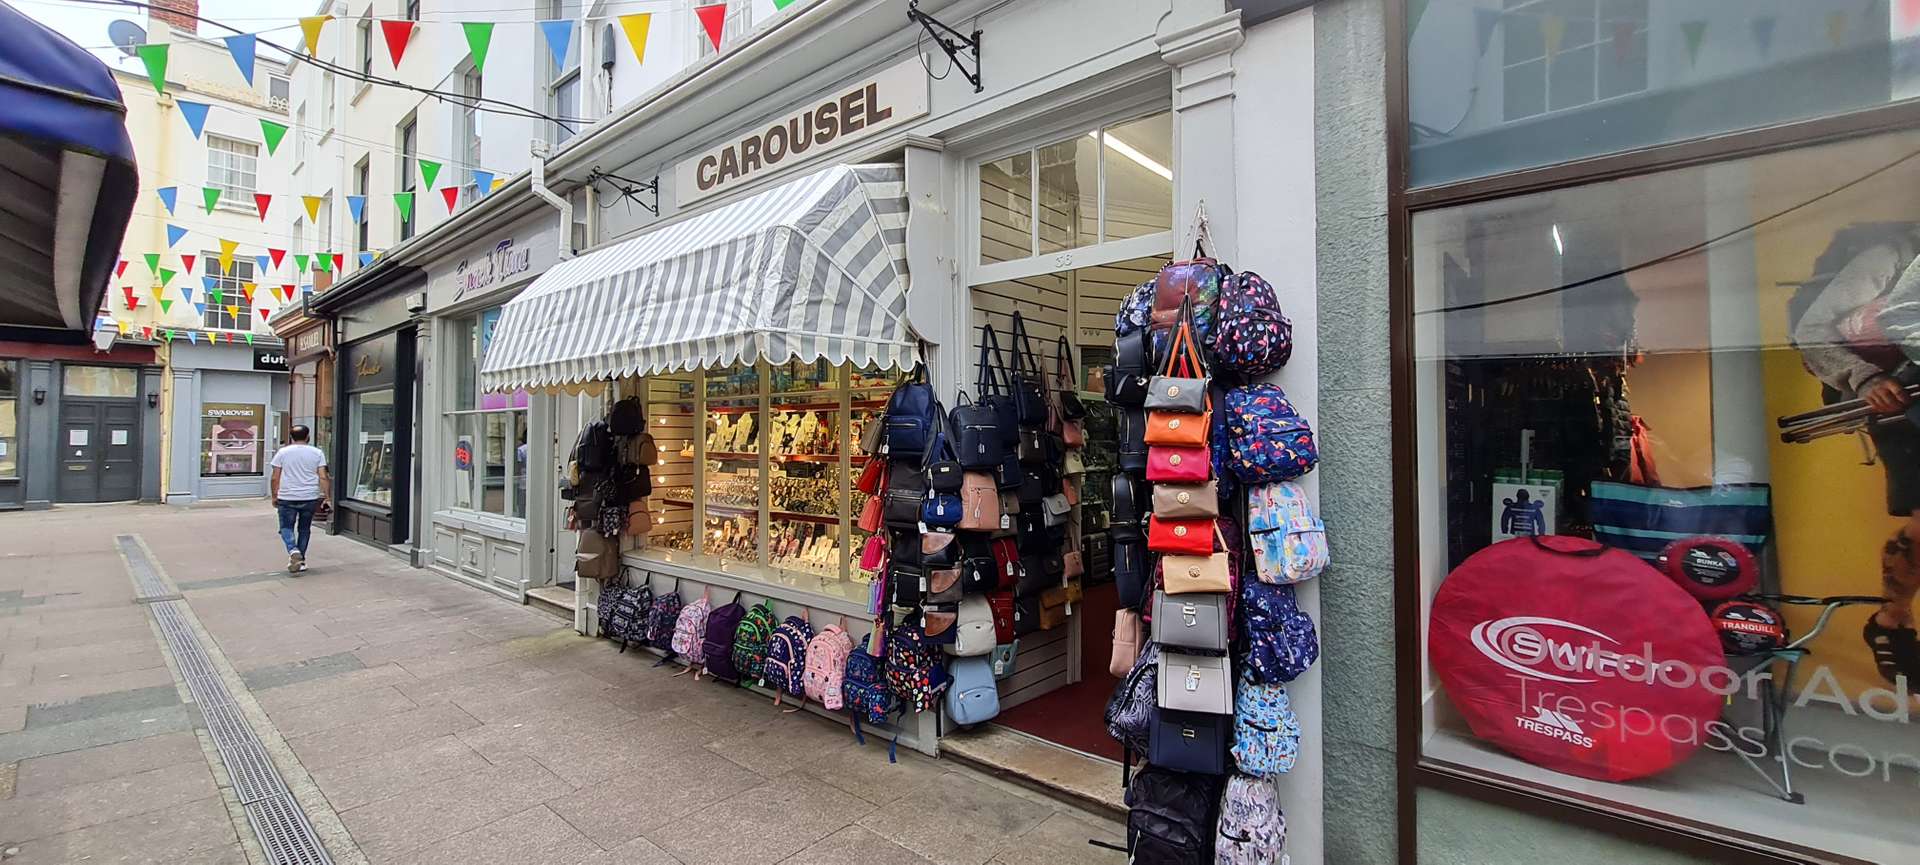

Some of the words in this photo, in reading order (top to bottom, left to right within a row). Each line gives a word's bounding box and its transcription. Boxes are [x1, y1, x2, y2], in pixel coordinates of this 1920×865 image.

[697, 82, 892, 191] CAROUSEL
[1722, 621, 1776, 634] TRANQUILL
[1501, 625, 1773, 700] Outdoor
[1793, 665, 1920, 724] Ad
[1515, 716, 1593, 749] TRESPASS
